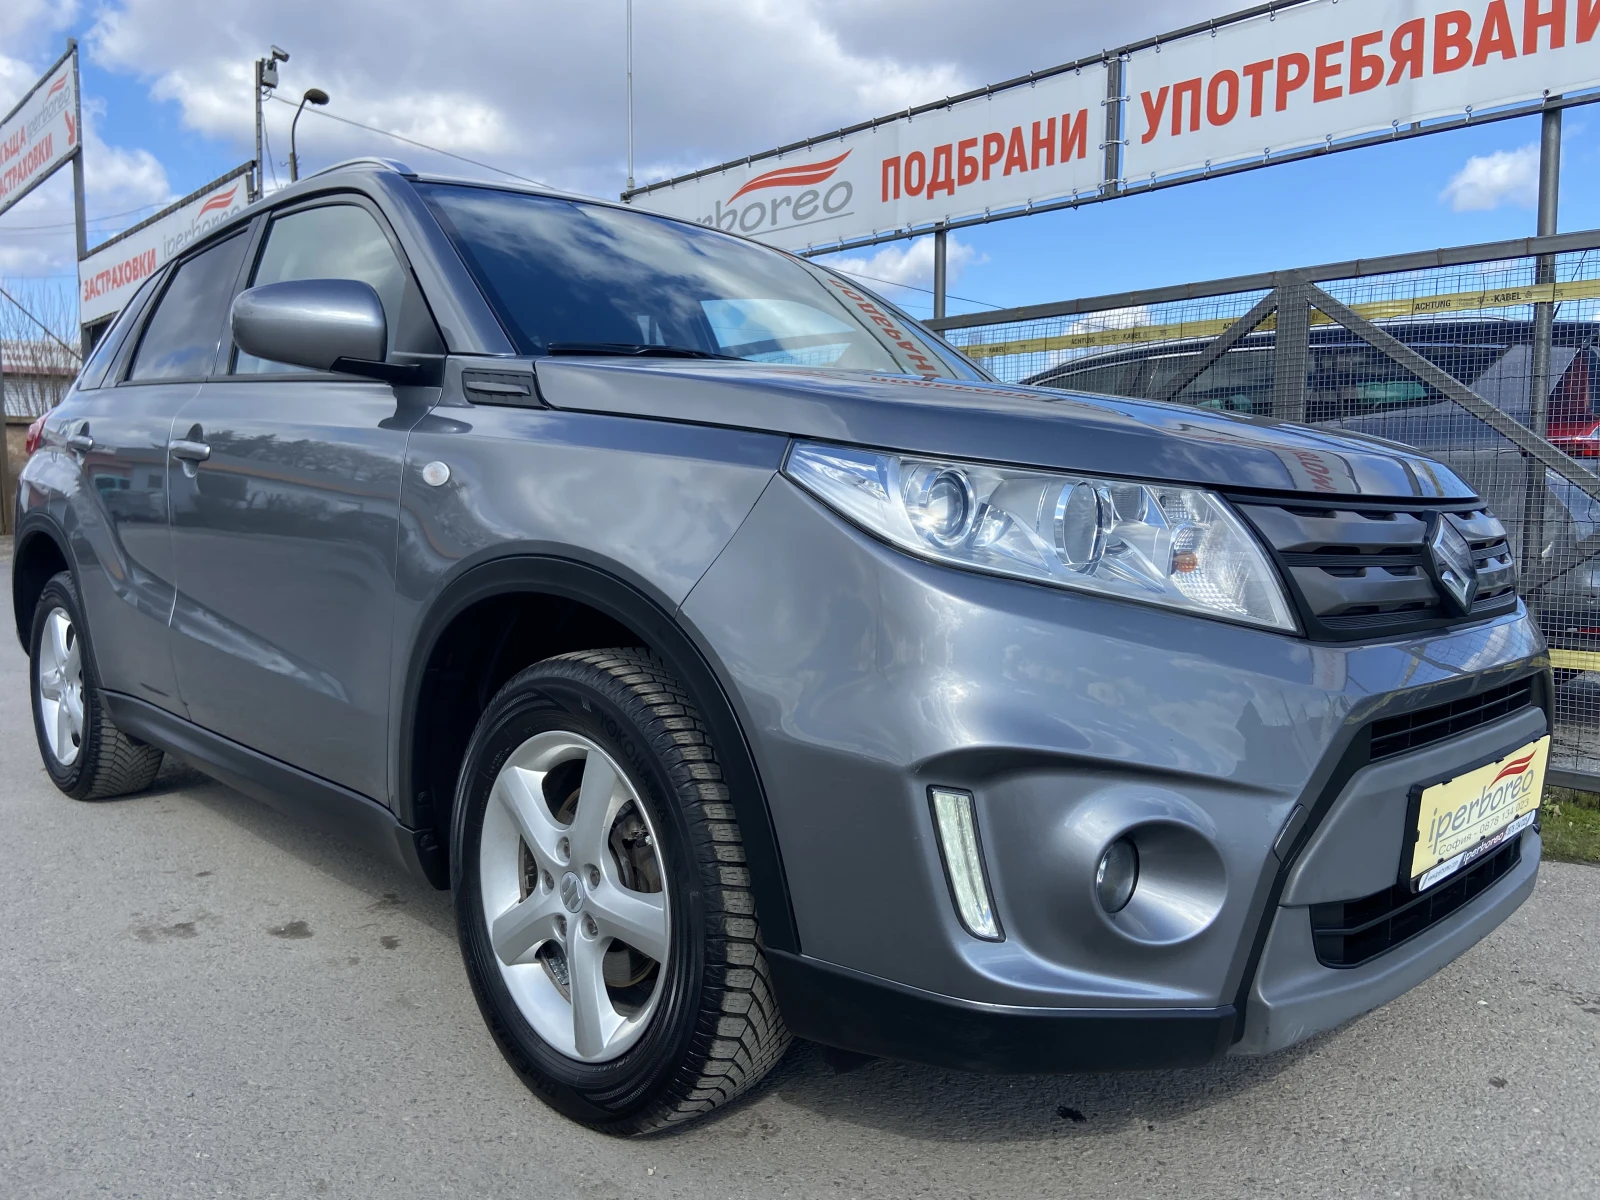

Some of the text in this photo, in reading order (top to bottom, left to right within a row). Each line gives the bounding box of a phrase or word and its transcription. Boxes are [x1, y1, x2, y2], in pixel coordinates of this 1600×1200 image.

[881, 108, 1088, 202] ПОДБРАНИ
[84, 248, 156, 302] ЗАСТРАХОВКИ
[1414, 299, 1451, 311] ACHTUNG
[1494, 292, 1522, 303] KABEL
[1071, 336, 1096, 345] ACHTUNG
[1428, 769, 1534, 855] iperboreo
[1438, 833, 1471, 856] София
[1480, 816, 1500, 834] 0878
